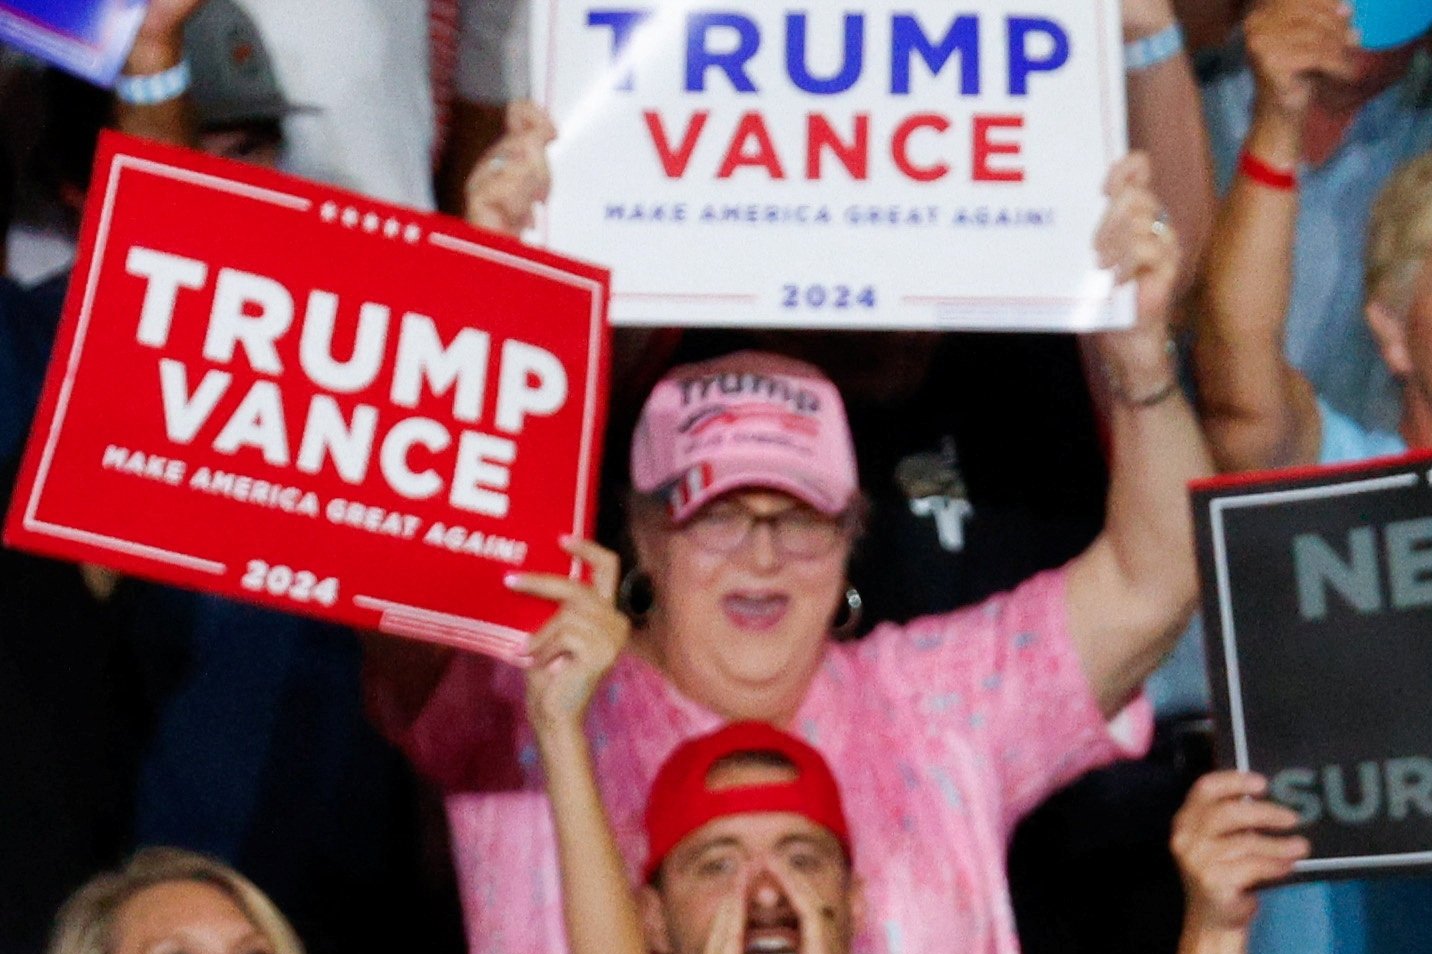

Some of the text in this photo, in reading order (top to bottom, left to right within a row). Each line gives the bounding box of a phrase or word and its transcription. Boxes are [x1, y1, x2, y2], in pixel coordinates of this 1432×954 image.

[585, 8, 1073, 98] TRUMP
[643, 111, 1026, 184] VANCE
[603, 202, 688, 224] MAKE
[699, 204, 833, 226] AMERICA
[845, 206, 940, 227] GREAT
[780, 282, 880, 312] 2024
[125, 246, 568, 433] TRUMP
[159, 358, 517, 517] VANCE
[102, 443, 528, 565] MAKE AMERICA GREAT AGAIN!
[240, 559, 340, 606] 2024
